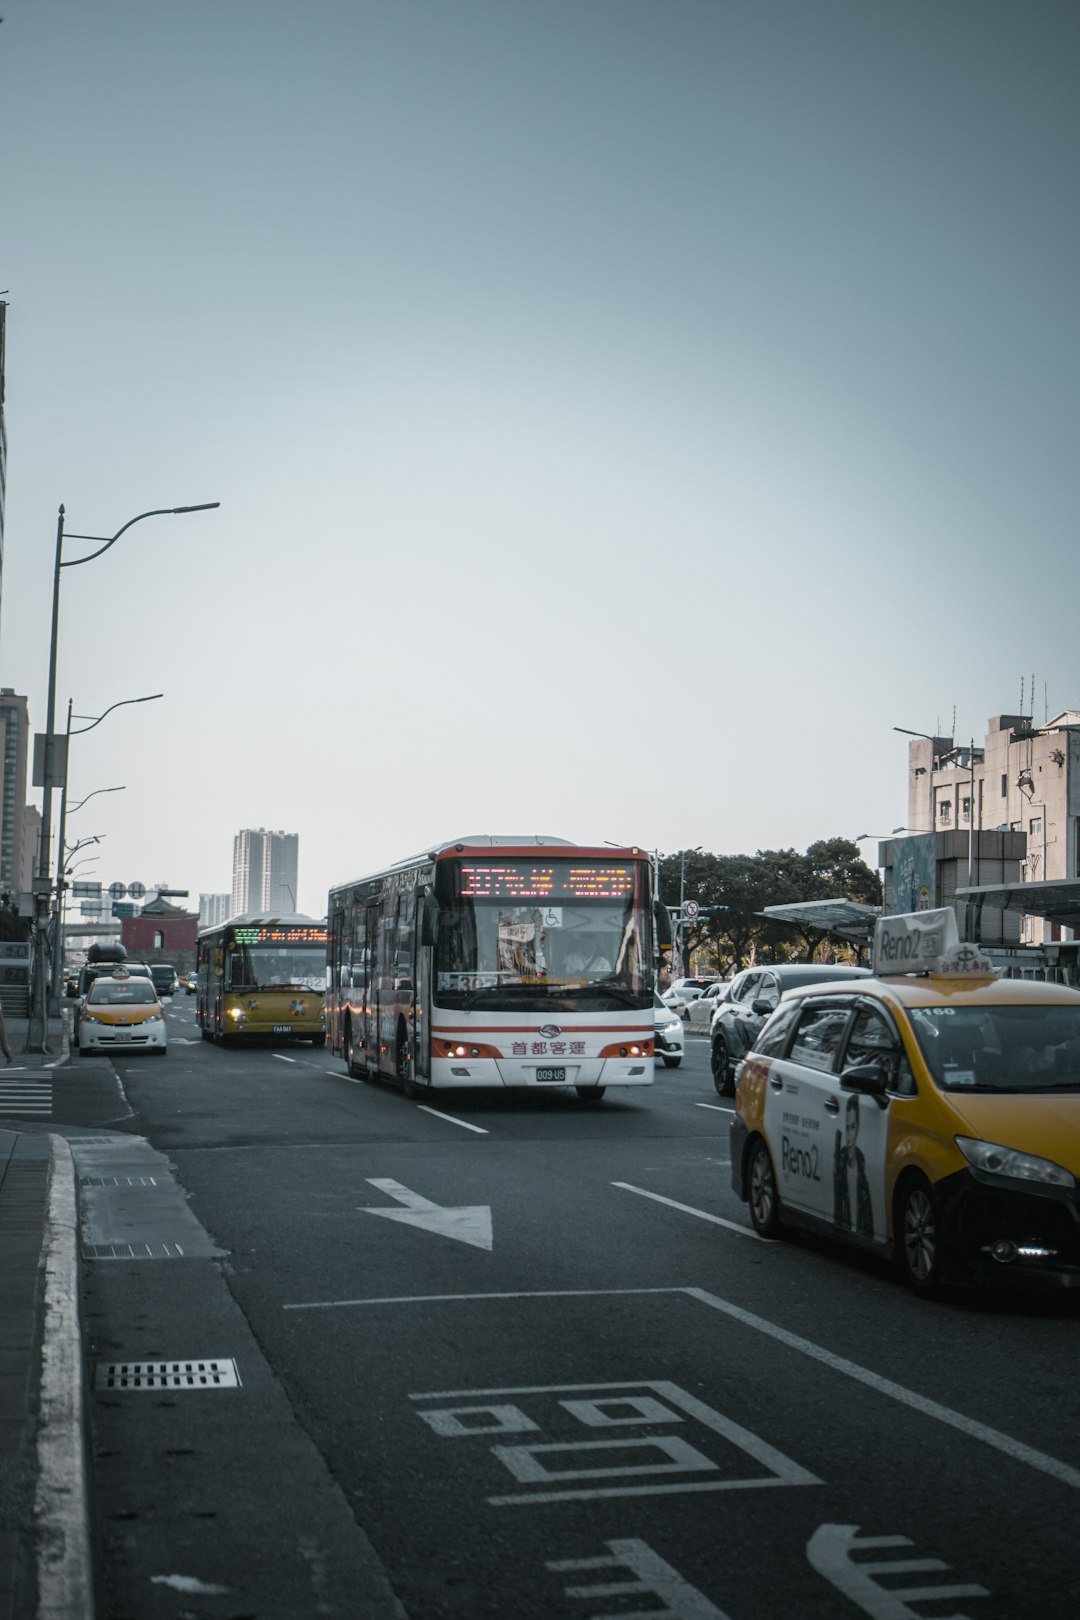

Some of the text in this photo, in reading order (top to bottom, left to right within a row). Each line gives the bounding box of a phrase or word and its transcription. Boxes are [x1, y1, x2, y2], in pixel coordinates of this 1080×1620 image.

[879, 928, 921, 962] Reno2
[942, 960, 990, 973] 台灣大車隊
[910, 1007, 956, 1016] 5160
[511, 1041, 586, 1056] 首都客運
[781, 1135, 821, 1182] Reno2
